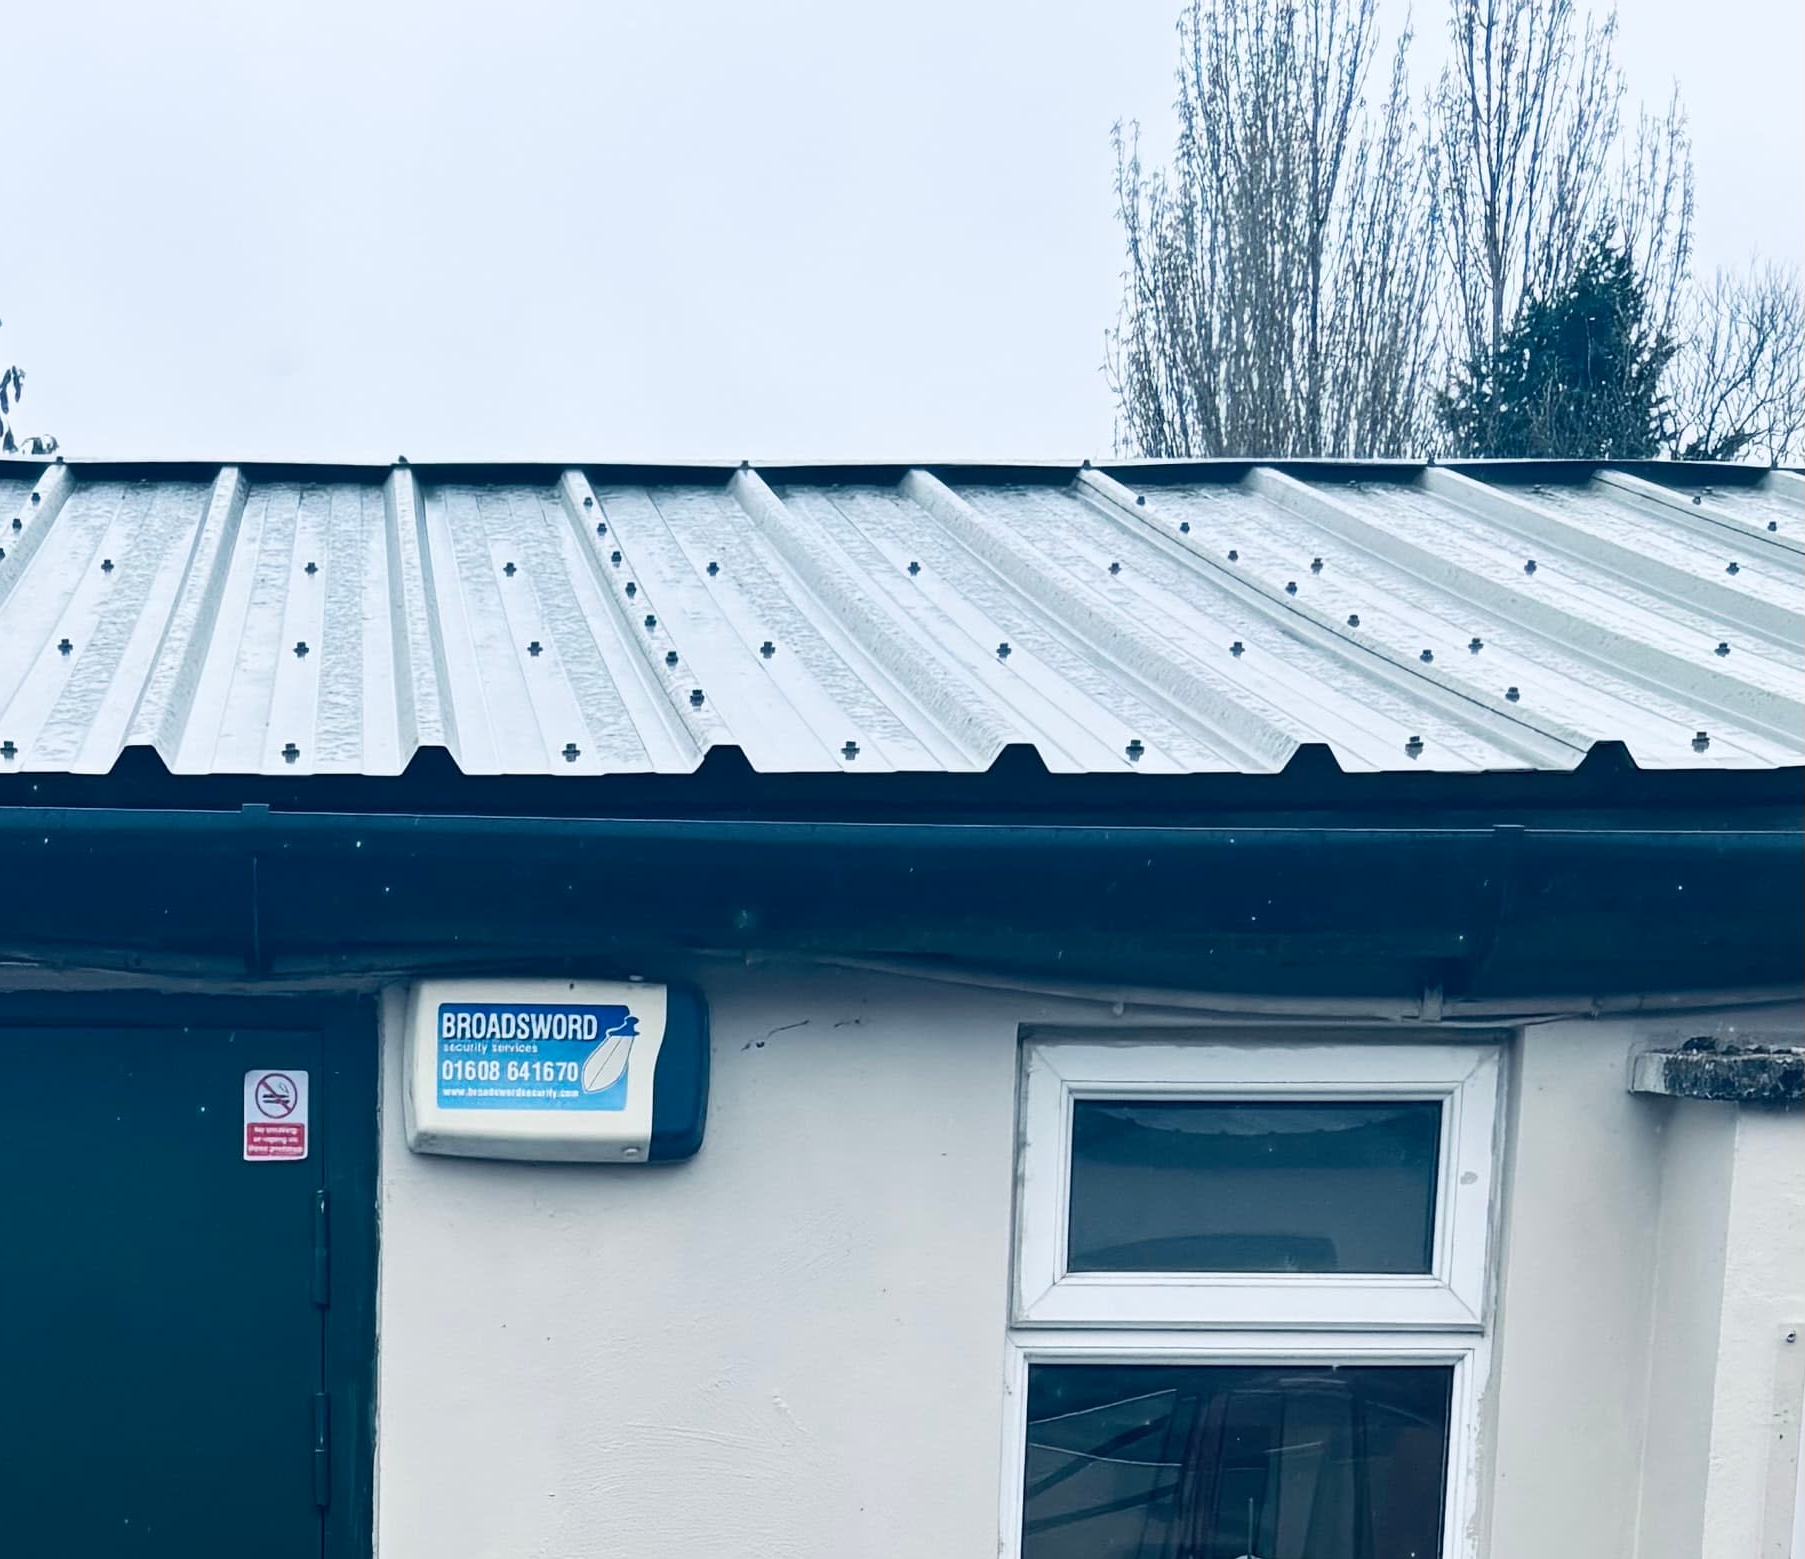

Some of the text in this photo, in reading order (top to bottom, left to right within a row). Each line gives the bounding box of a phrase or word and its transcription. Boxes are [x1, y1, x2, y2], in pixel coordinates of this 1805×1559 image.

[442, 1012, 598, 1040] BROADSWORD
[443, 1042, 538, 1054] security services
[442, 1060, 579, 1082] 01608 641670
